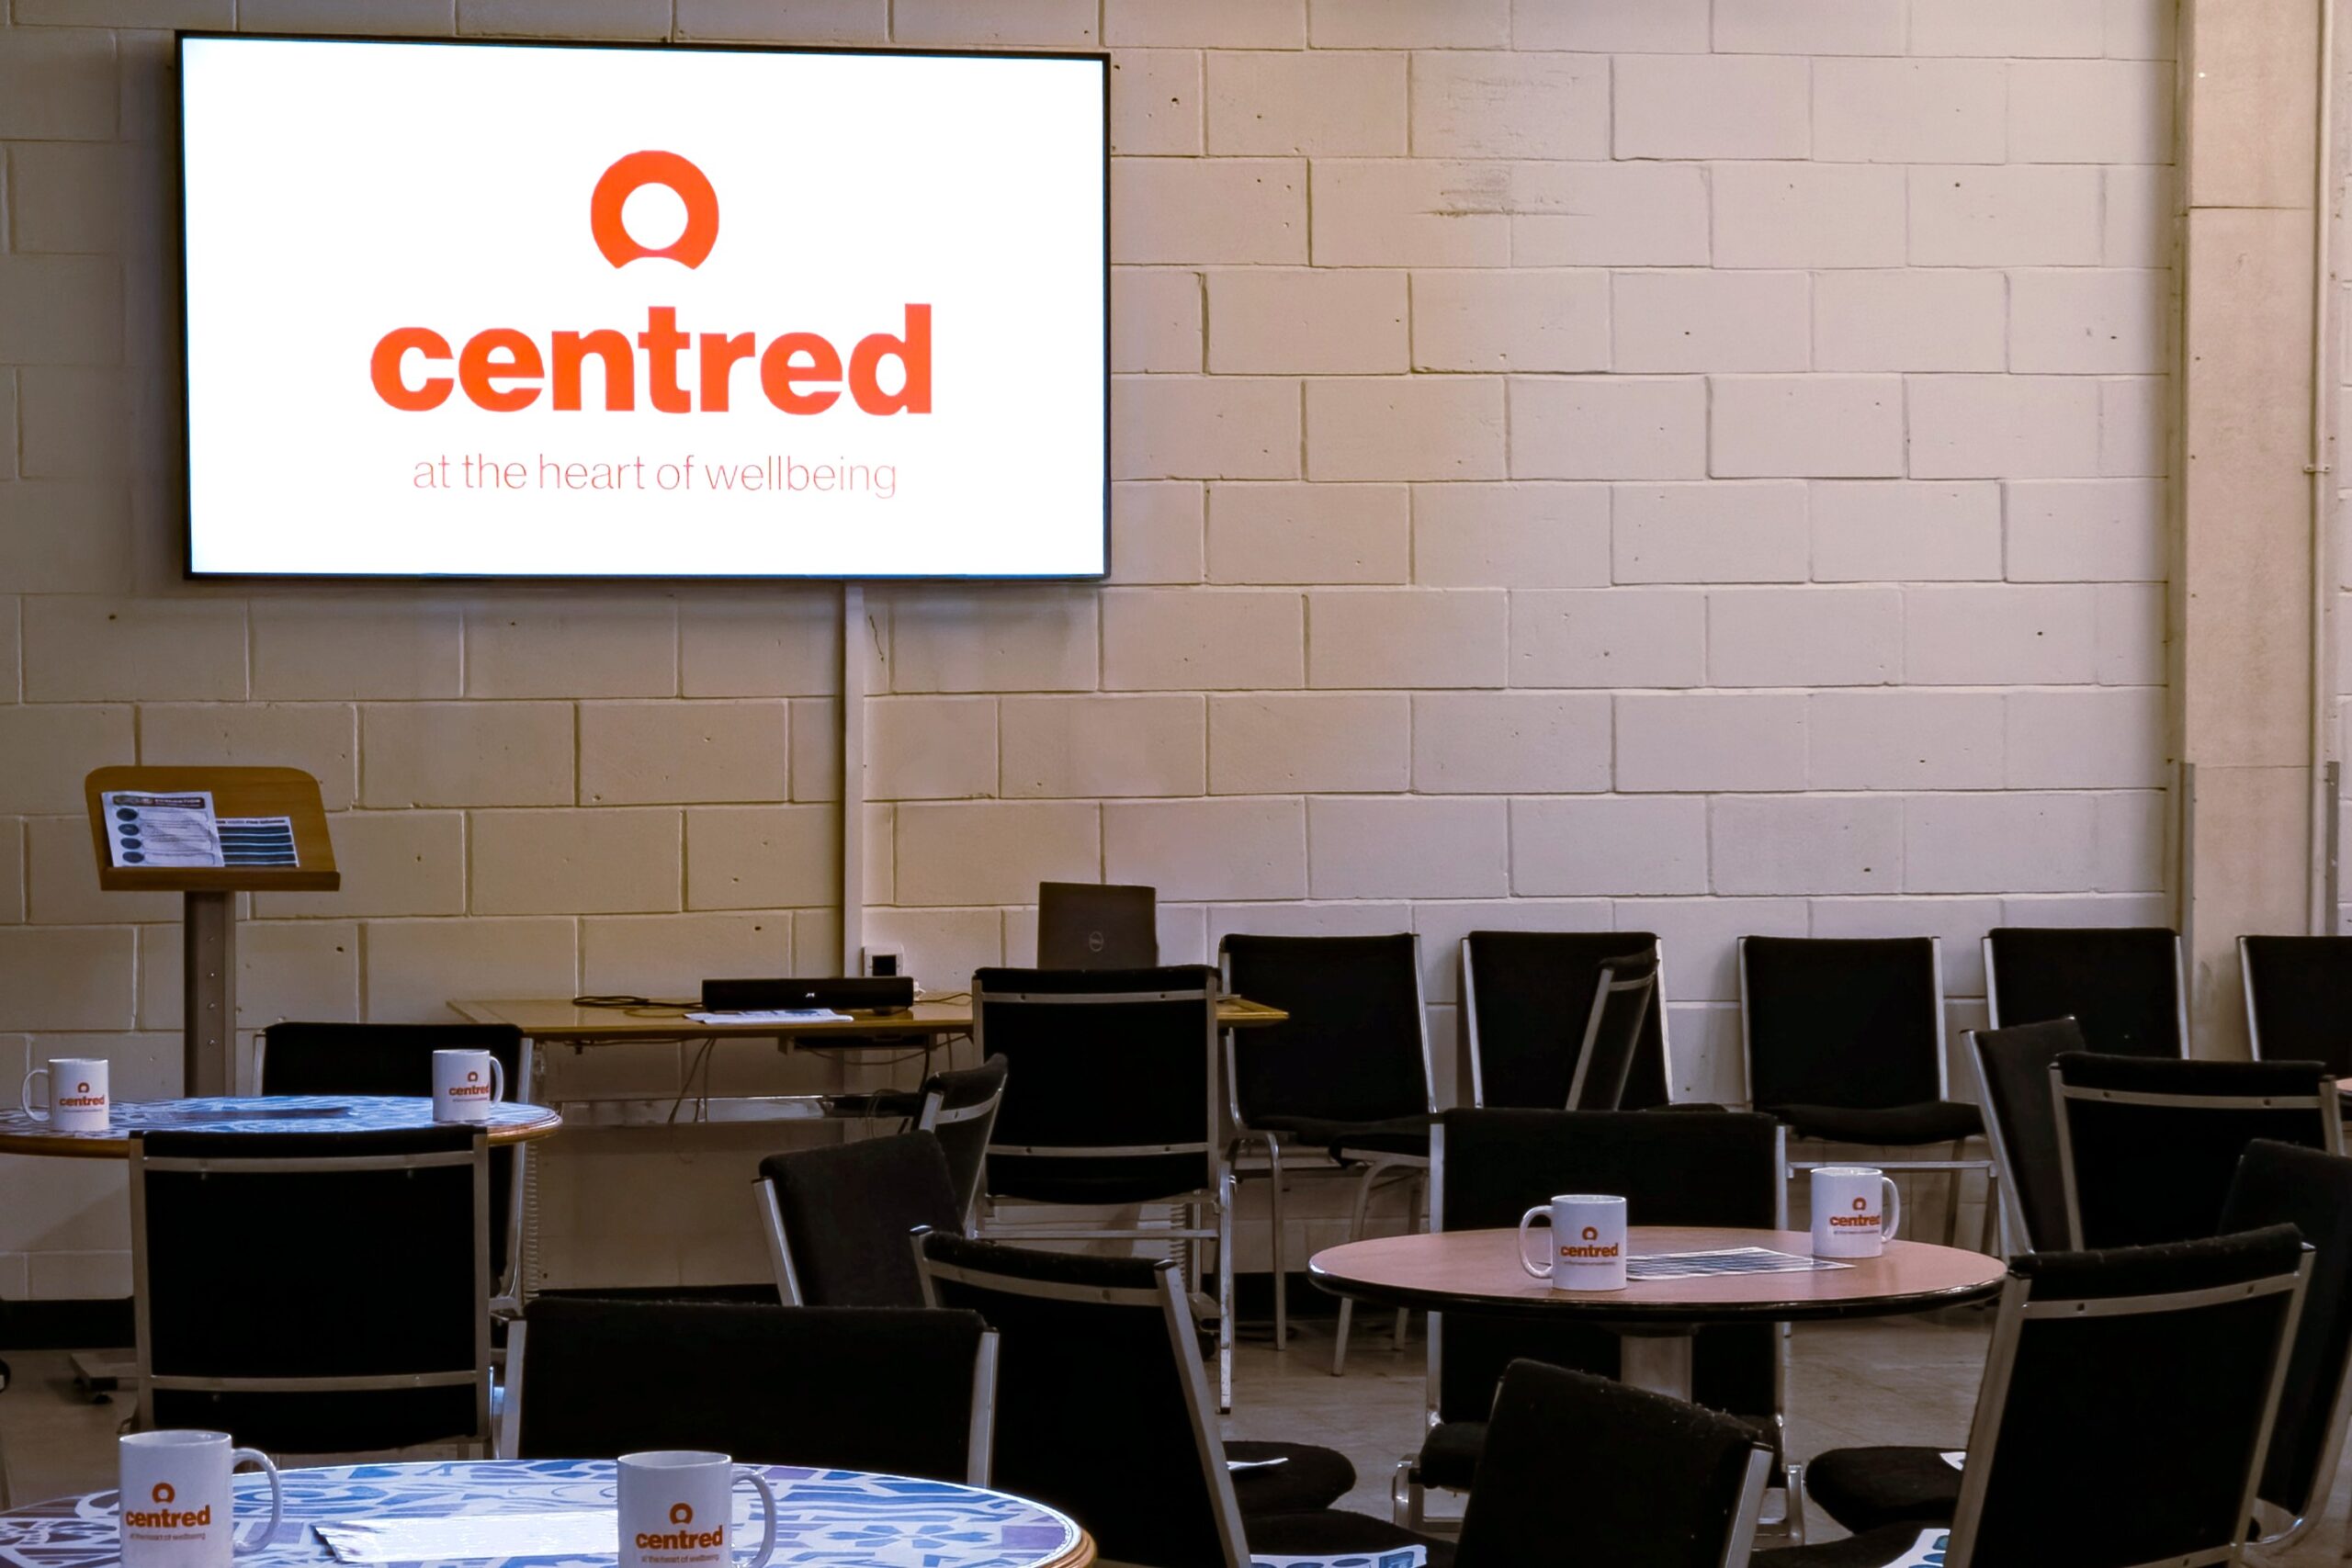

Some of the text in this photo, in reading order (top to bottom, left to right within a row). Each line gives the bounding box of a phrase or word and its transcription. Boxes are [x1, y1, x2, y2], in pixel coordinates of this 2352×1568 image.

[370, 303, 933, 416] centred
[413, 453, 897, 499] at the heart of wellbeing
[59, 1093, 105, 1106] centred
[1560, 1242, 1619, 1258] centred
[126, 1505, 210, 1528] centred
[636, 1525, 723, 1549] centred
